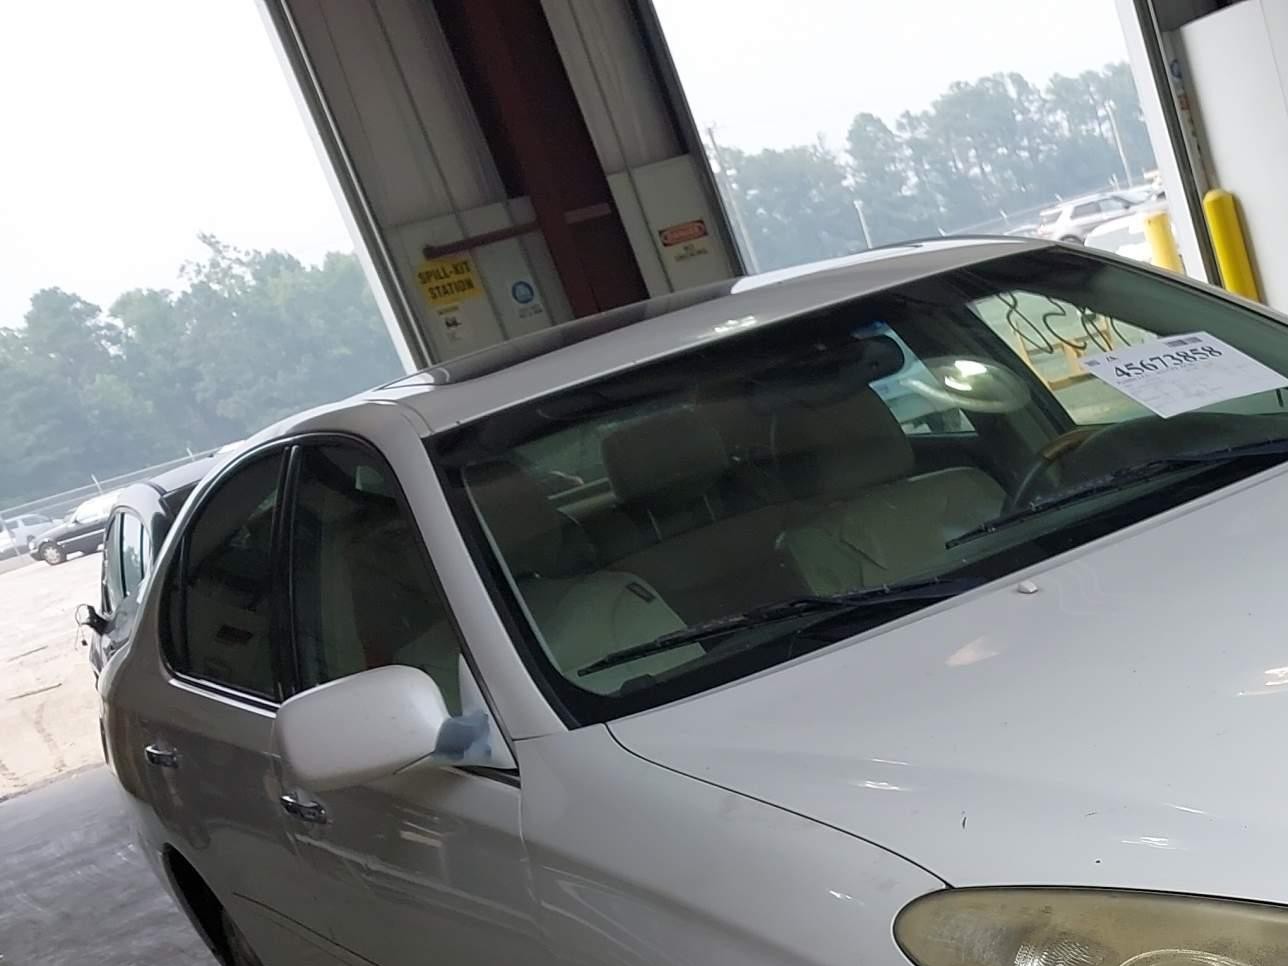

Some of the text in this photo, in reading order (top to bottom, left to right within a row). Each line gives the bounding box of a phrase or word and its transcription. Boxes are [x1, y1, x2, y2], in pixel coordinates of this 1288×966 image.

[417, 261, 471, 285] SPILL-KIT
[428, 279, 474, 300] STATION
[1114, 346, 1223, 378] 45673858
